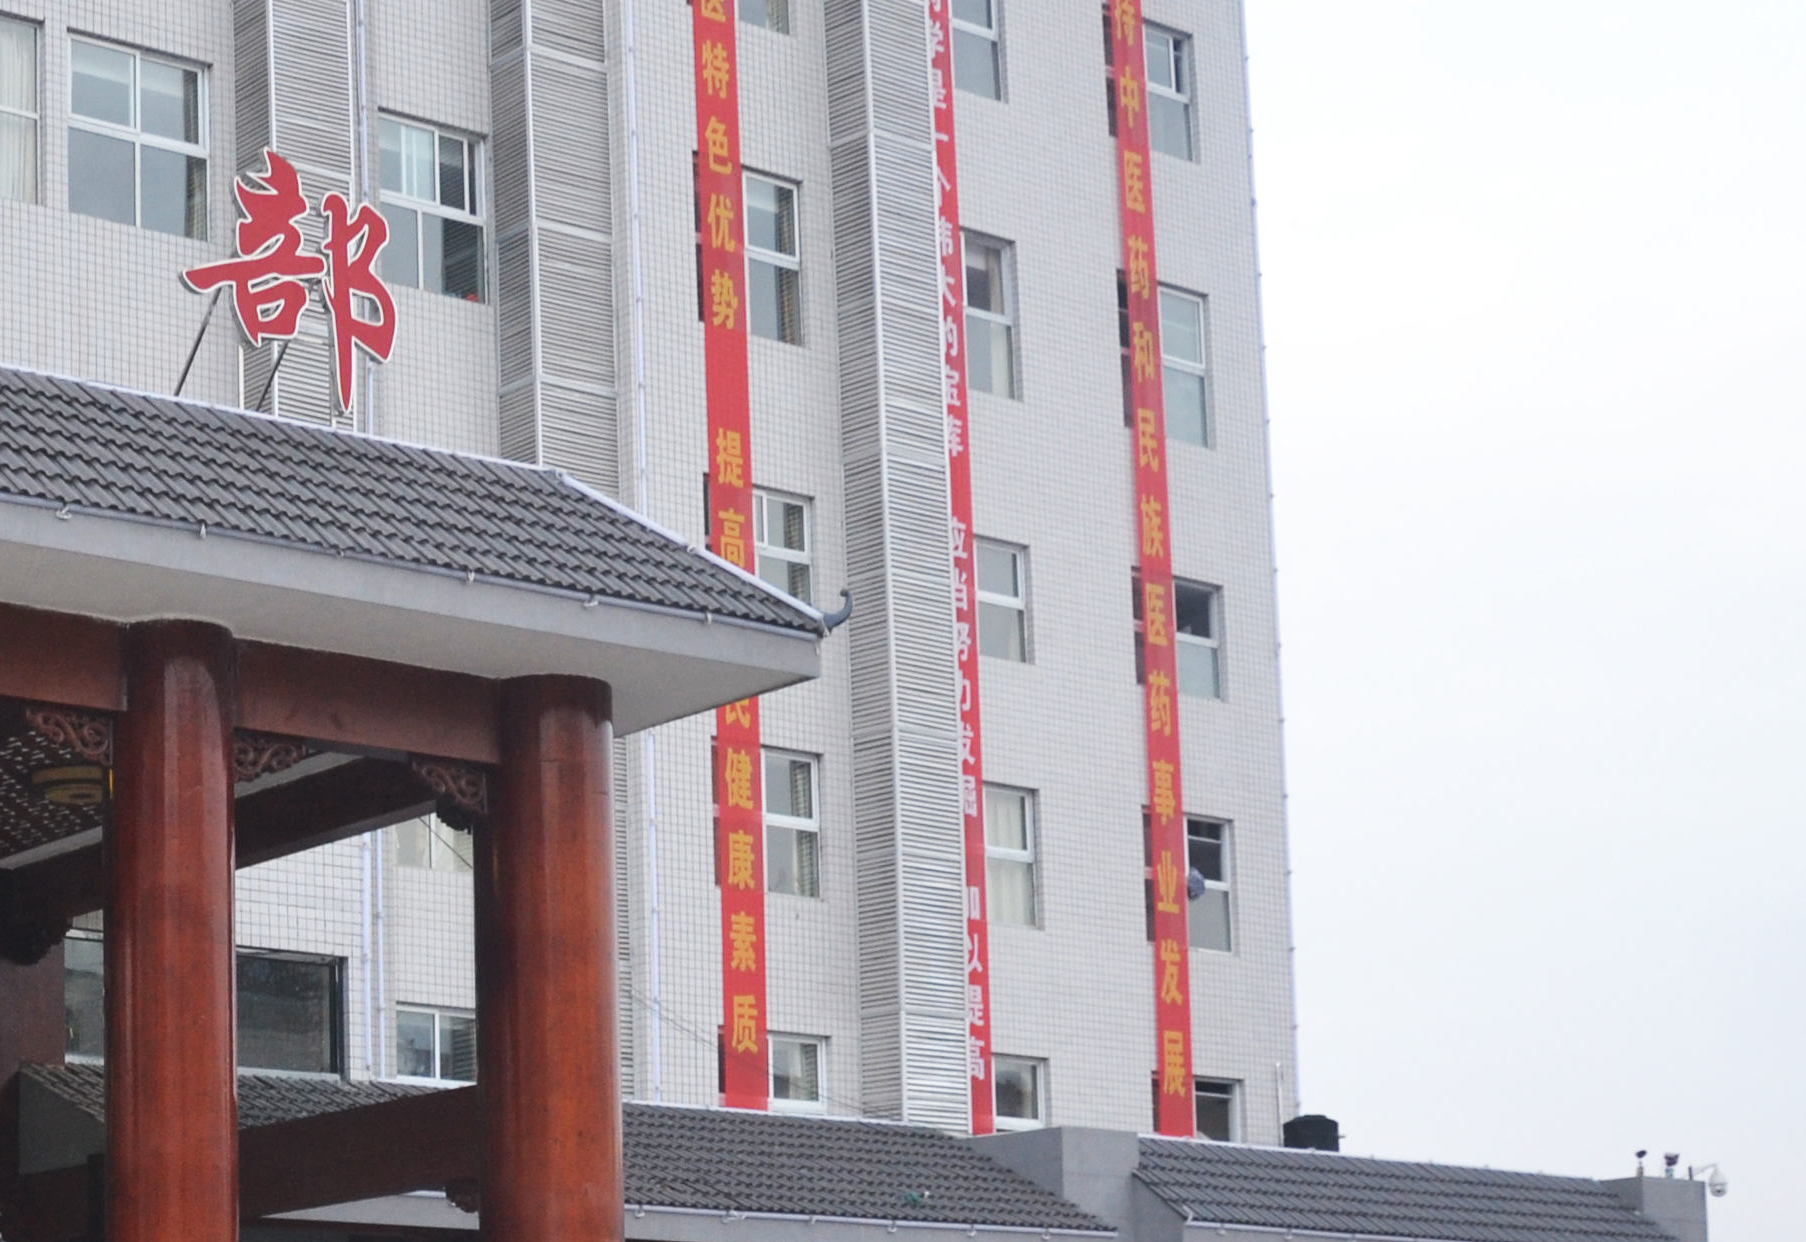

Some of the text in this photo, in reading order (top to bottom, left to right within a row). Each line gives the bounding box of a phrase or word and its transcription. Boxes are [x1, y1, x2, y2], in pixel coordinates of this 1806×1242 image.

[929, 0, 964, 457] 学是一个伟大的宝库
